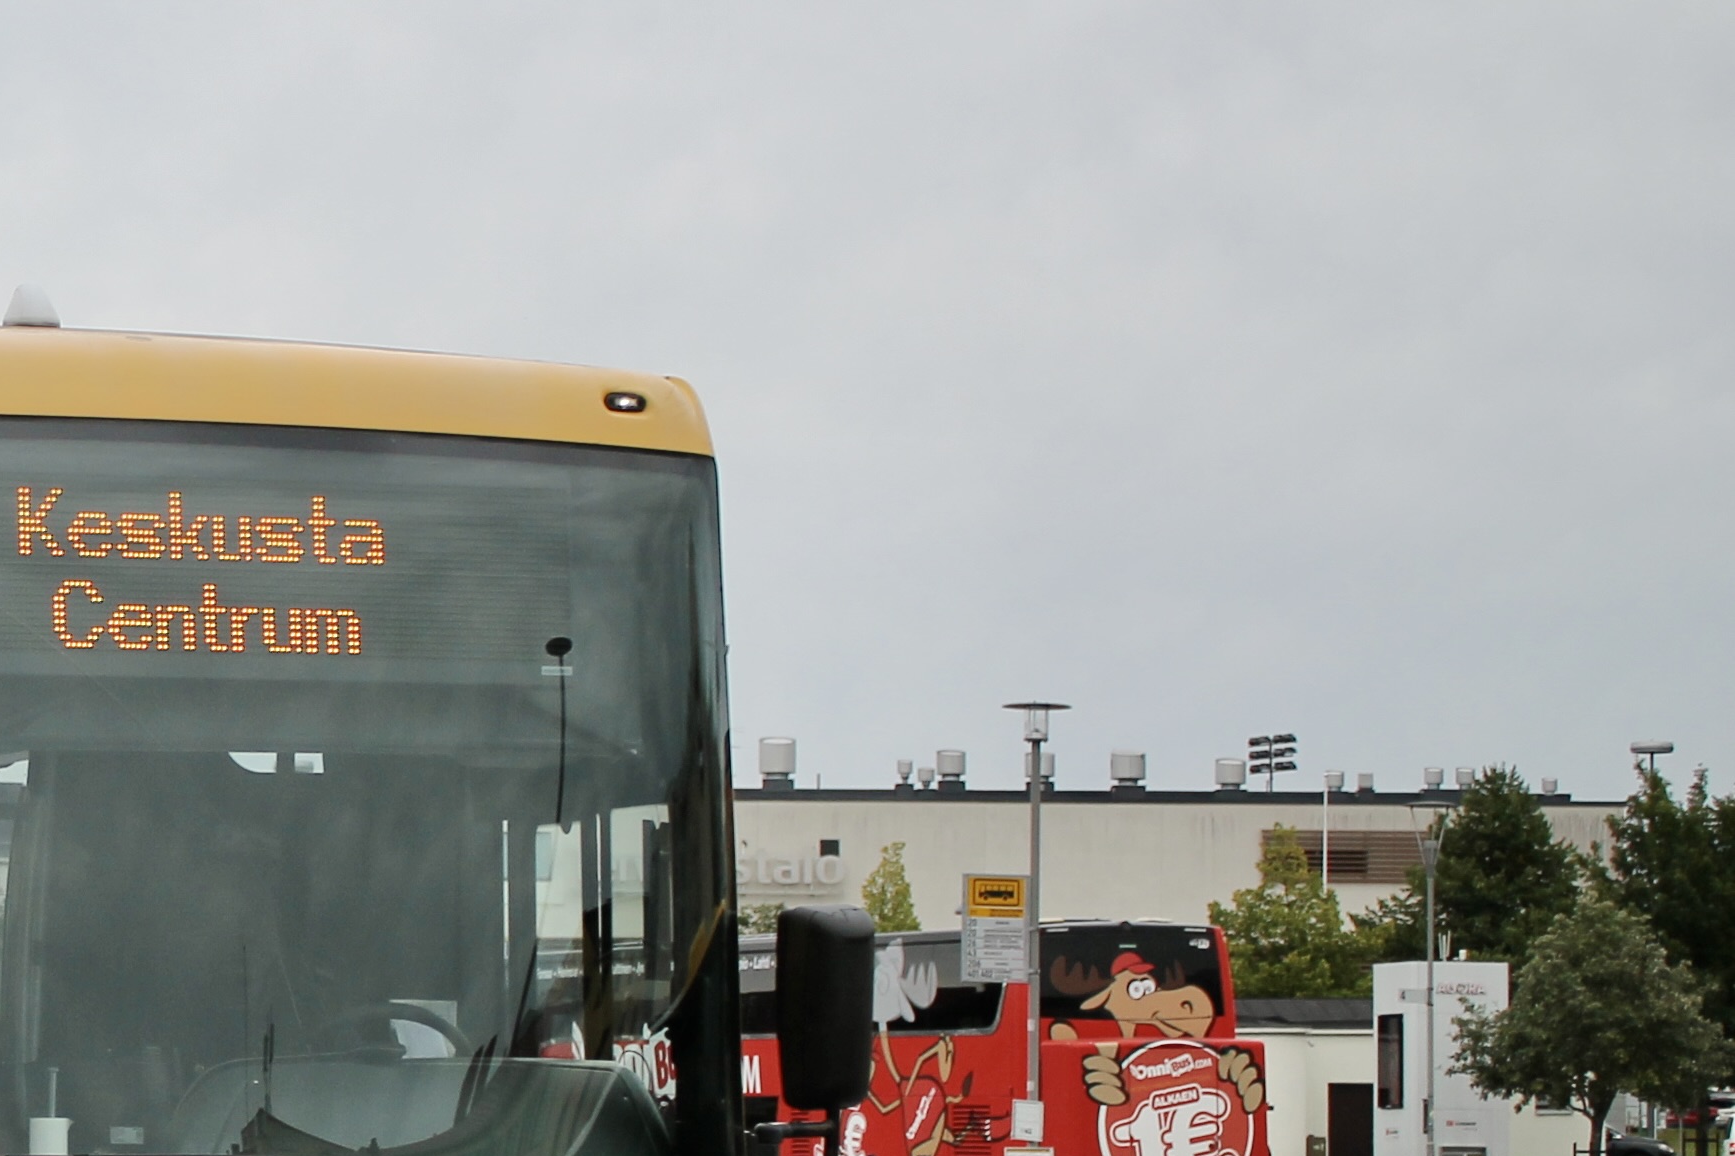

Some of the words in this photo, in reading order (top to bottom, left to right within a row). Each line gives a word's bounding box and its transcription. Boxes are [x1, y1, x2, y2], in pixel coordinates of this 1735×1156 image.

[16, 486, 385, 566] Keskusta
[50, 578, 362, 656] Centrum
[1153, 1088, 1197, 1108] ALKAEN
